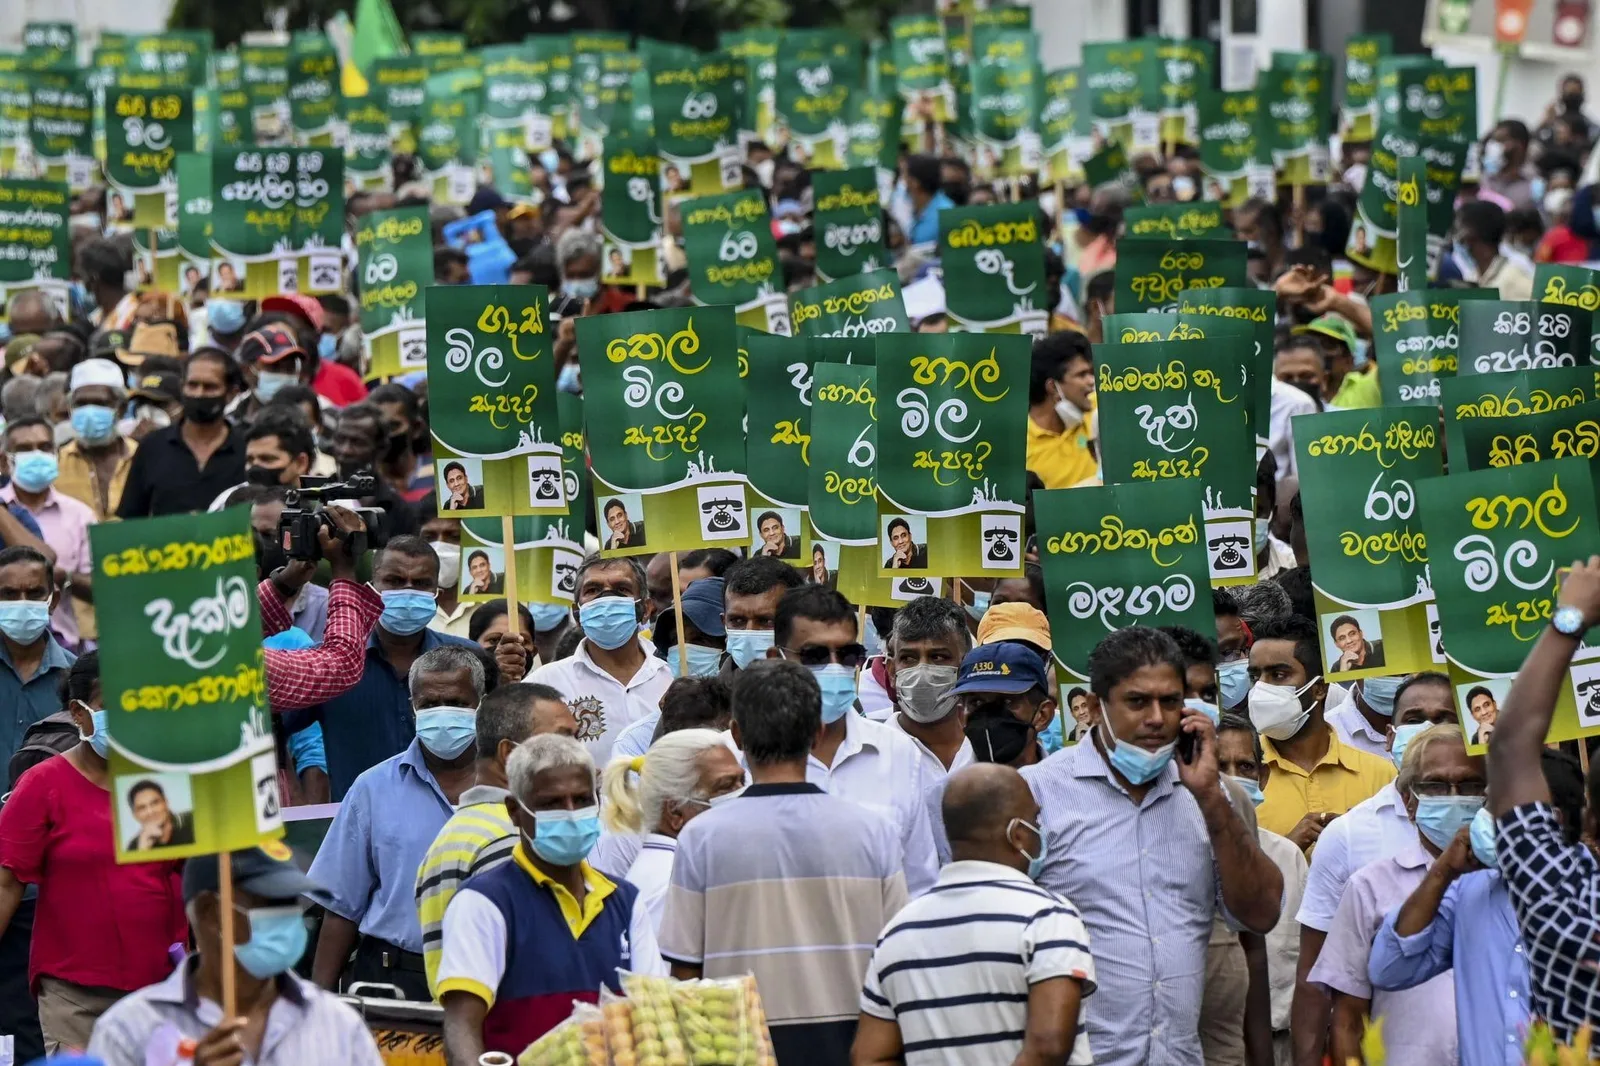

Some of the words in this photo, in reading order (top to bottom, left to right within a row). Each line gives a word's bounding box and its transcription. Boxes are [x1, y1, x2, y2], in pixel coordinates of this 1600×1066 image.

[123, 117, 172, 150] මිල
[365, 253, 398, 284] රට
[719, 230, 758, 262] රට
[974, 249, 1037, 295] නෑ
[824, 283, 895, 314] පාලනය
[477, 296, 543, 360] ගෑස්
[606, 316, 711, 374] තෙල්
[1493, 312, 1530, 336] කිරි
[1538, 313, 1571, 338] පිටි
[445, 328, 511, 387] මිල
[910, 346, 1010, 402] හාල්
[469, 384, 538, 429] සැපද?
[623, 365, 694, 419] මිල
[1193, 369, 1238, 403] නෑ
[623, 412, 706, 461] සැපද?
[896, 387, 981, 443] මිල
[1134, 391, 1198, 453] දැන්
[913, 441, 992, 486] සැපද?
[1308, 421, 1396, 468] හොරු
[1364, 472, 1415, 521] රට
[1465, 473, 1580, 538] හාල්
[1047, 513, 1198, 567] ගොවිතැනේ
[1454, 534, 1554, 592] මිල
[144, 575, 249, 669] දැක්ම
[1066, 574, 1195, 632] මළගම
[972, 661, 994, 672] A330
